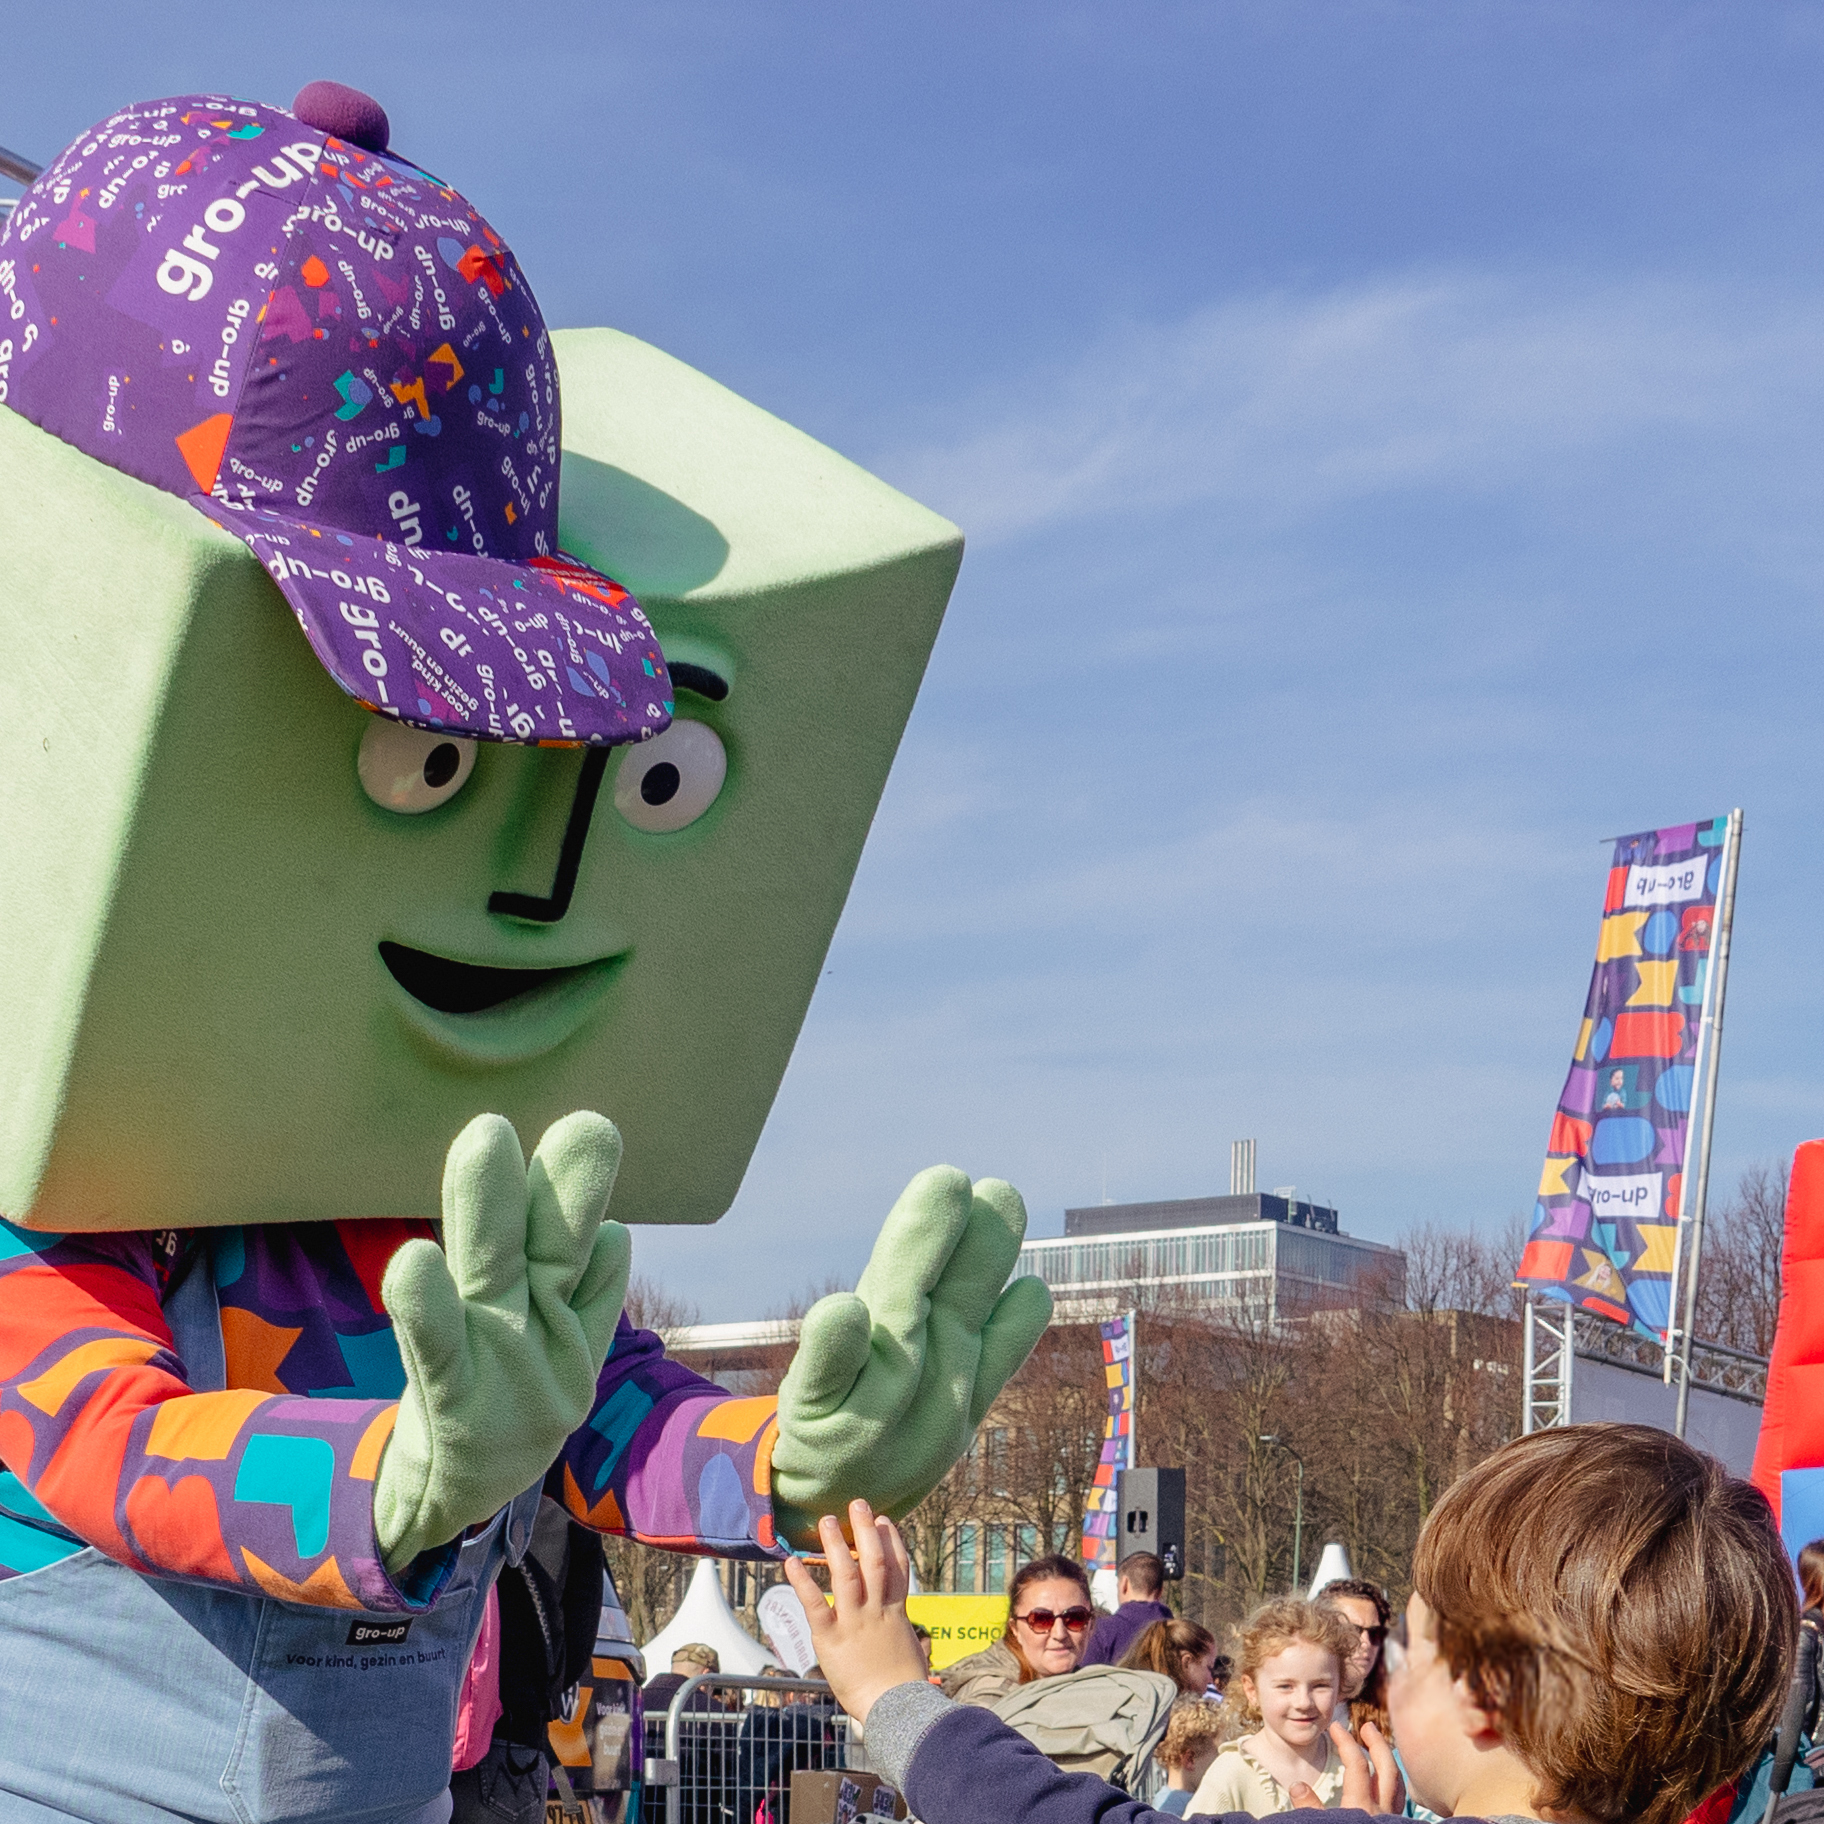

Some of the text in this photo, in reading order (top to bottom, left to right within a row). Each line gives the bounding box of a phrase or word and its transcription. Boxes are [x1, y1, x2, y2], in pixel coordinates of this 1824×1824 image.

[155, 142, 323, 302] gro-up
[337, 260, 372, 319] gro-up
[413, 245, 456, 330] gro-up
[477, 286, 513, 345] gro-up
[208, 299, 251, 397] gro-up
[102, 374, 120, 432] gro-up
[345, 422, 401, 453] gro-up
[425, 656, 444, 676] en
[477, 606, 547, 691] gro-up
[326, 1654, 357, 1670] kind,
[360, 1653, 397, 1671] gezin
[399, 1654, 415, 1666] en
[417, 1648, 446, 1663] buurt
[355, 1626, 406, 1640] gro-up
[957, 1626, 1002, 1640] SCHO
